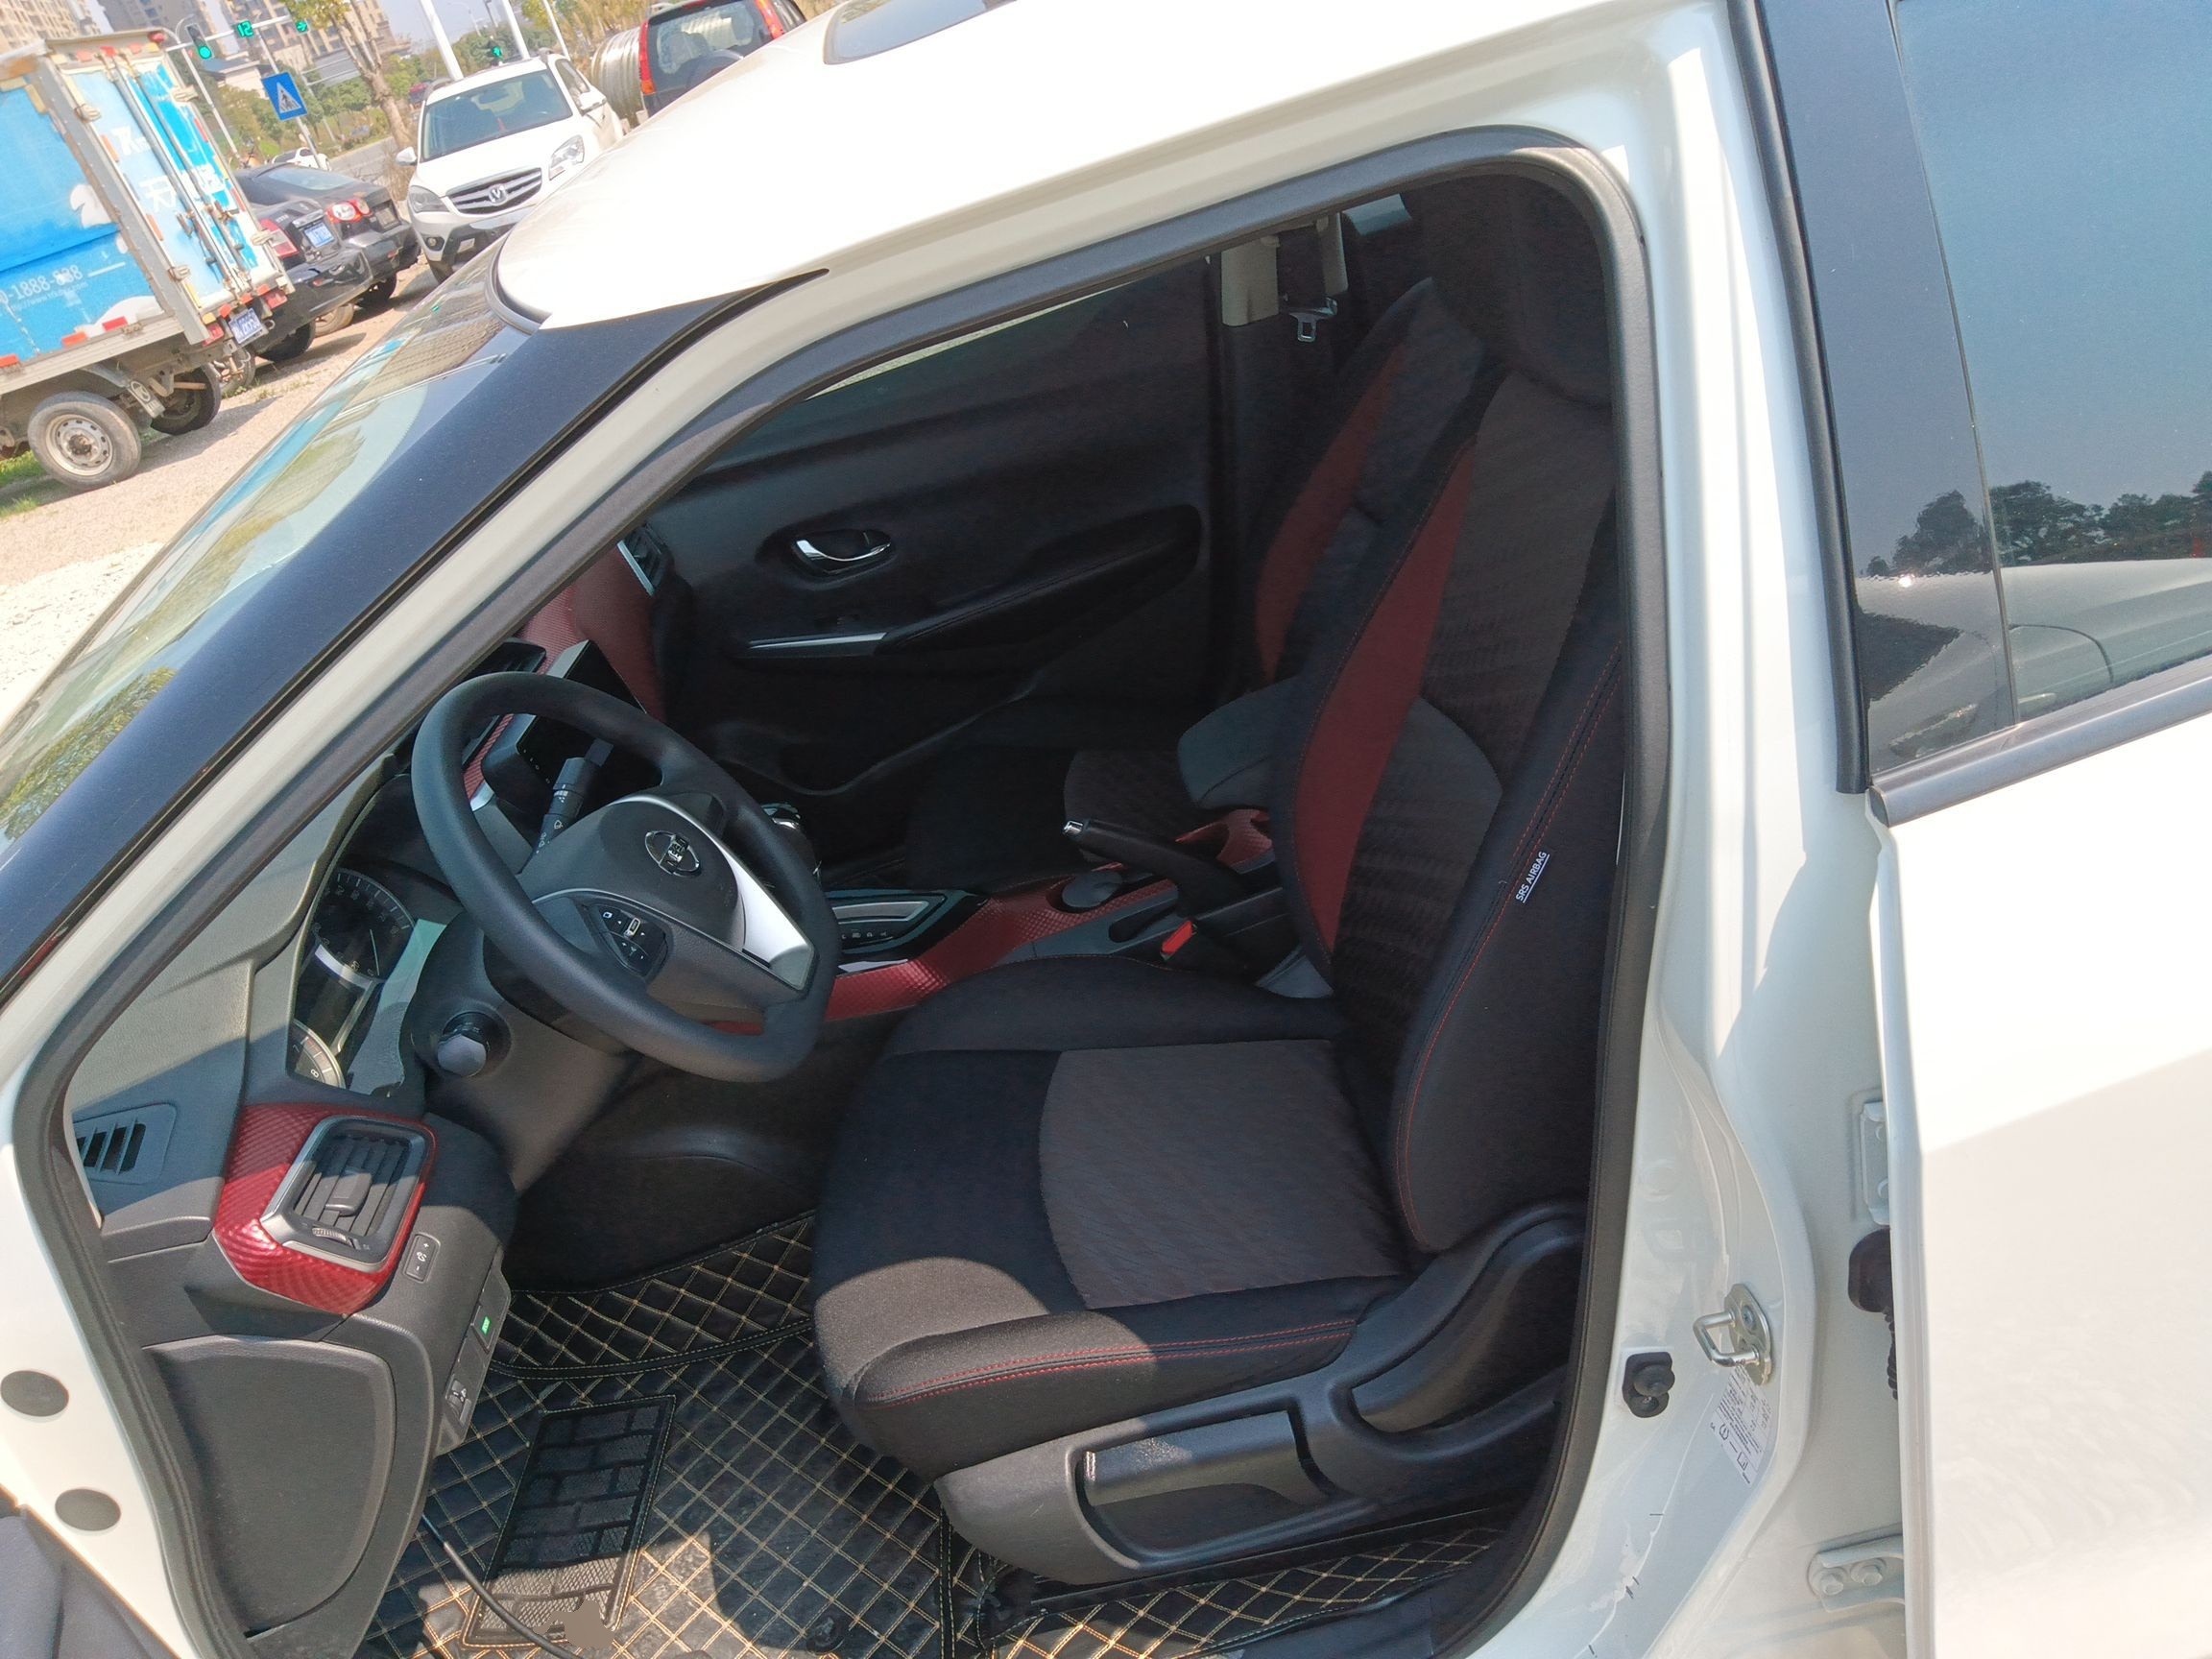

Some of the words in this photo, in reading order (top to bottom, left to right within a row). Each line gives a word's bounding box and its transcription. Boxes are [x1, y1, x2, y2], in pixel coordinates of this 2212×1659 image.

[237, 20, 254, 37] 12
[1516, 883, 1529, 902] SRS
[1526, 851, 1547, 884] AIRBAG
[310, 1068, 320, 1078] 8
